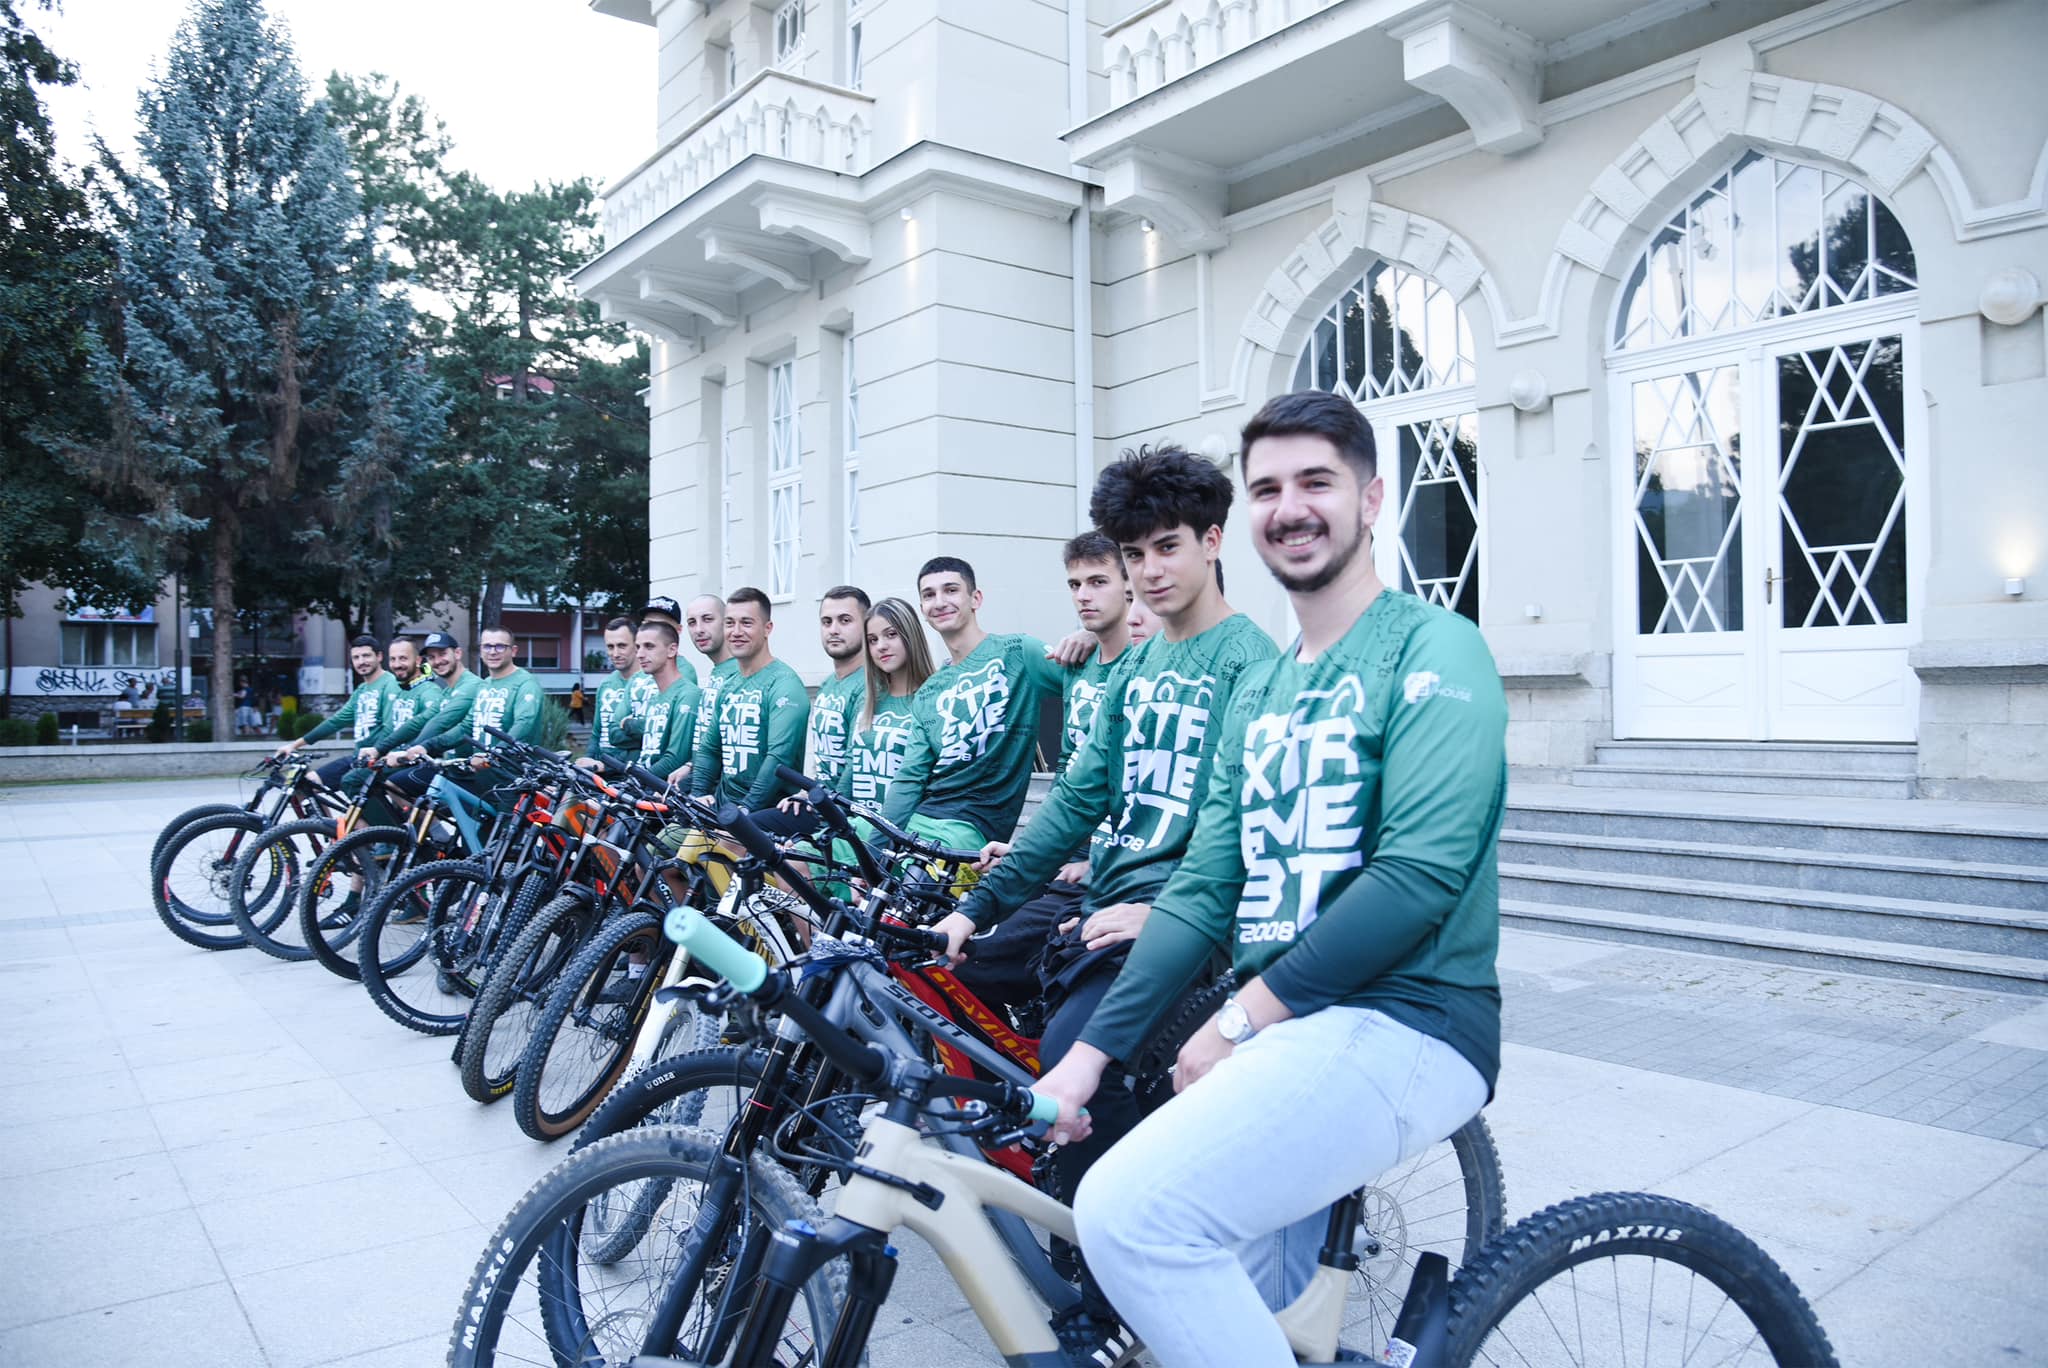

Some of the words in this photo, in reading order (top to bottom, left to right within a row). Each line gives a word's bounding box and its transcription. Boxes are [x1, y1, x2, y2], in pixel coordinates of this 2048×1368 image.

[720, 702, 761, 726] XTR
[719, 724, 761, 747] EME
[1239, 921, 1297, 944] 2008
[883, 984, 970, 1039] SCOTT
[652, 1070, 676, 1087] onza
[1568, 1224, 1683, 1254] MAXXIS
[462, 1236, 515, 1350] MAXXIS
